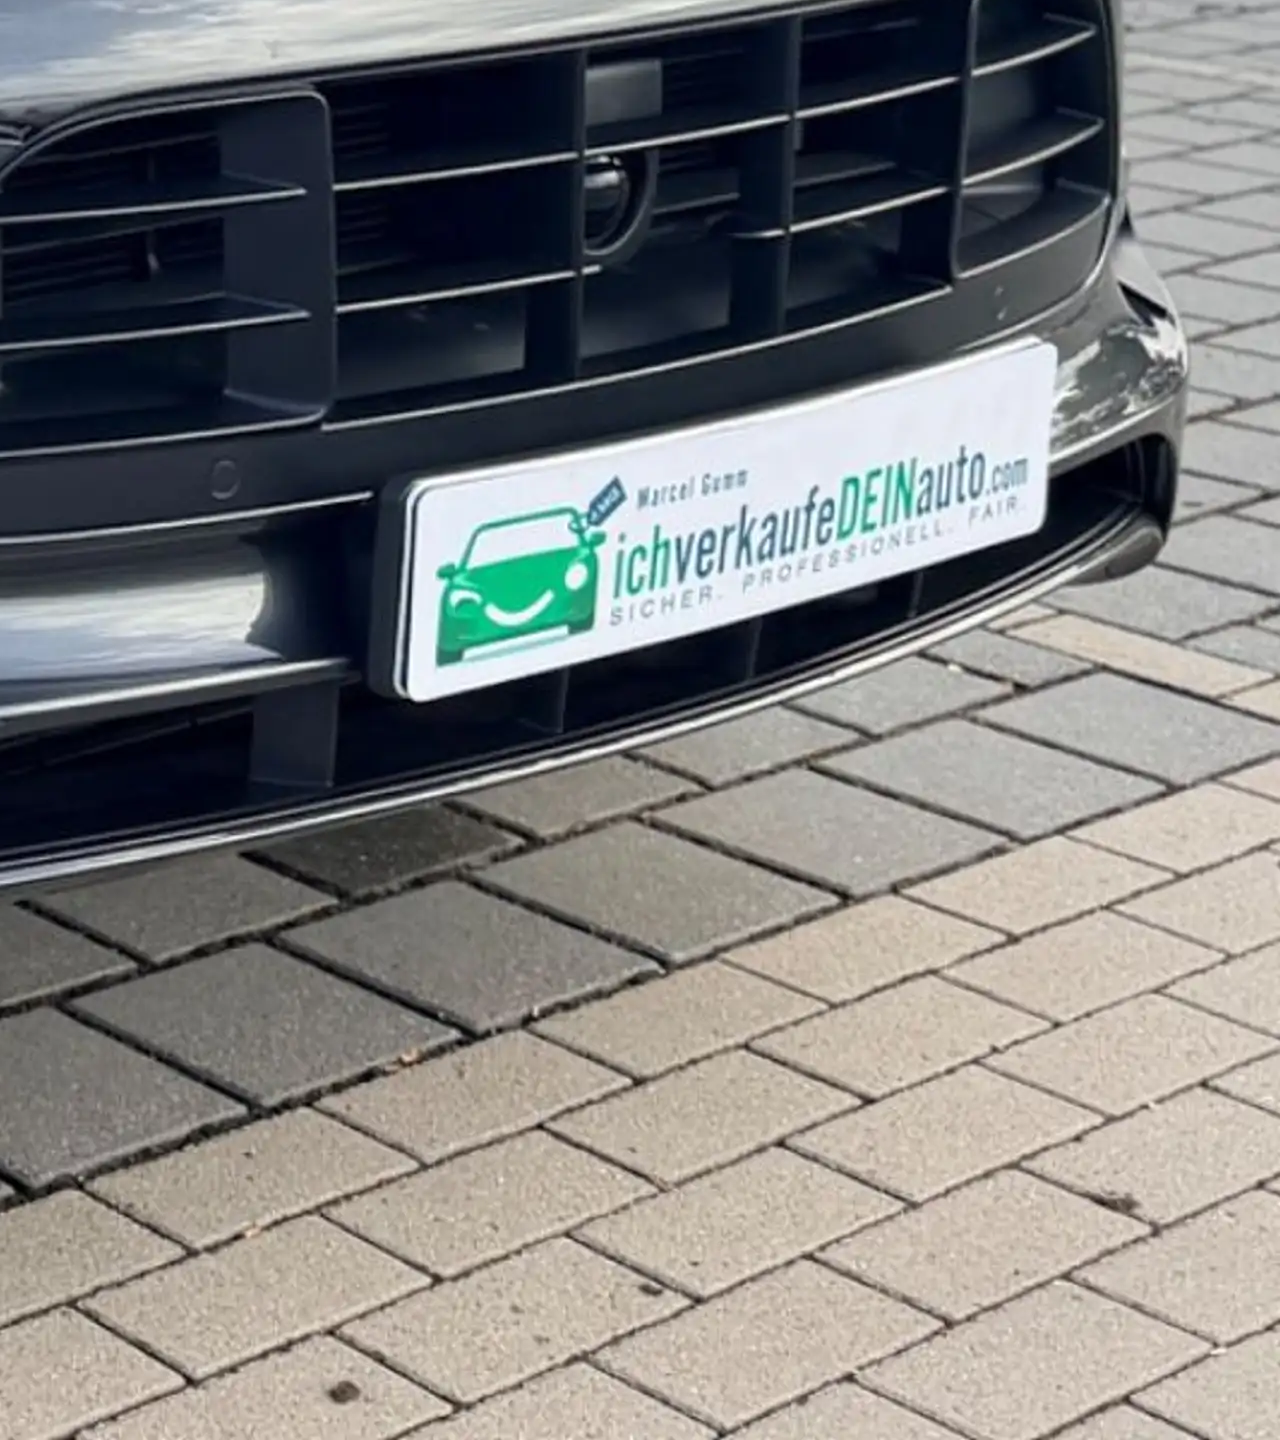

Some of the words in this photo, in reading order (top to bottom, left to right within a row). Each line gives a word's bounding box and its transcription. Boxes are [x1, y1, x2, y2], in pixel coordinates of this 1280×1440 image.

[638, 476, 695, 509] Marcel
[612, 444, 1030, 600] ichverkaufeDEINauto.com
[608, 585, 723, 627] SICHER.
